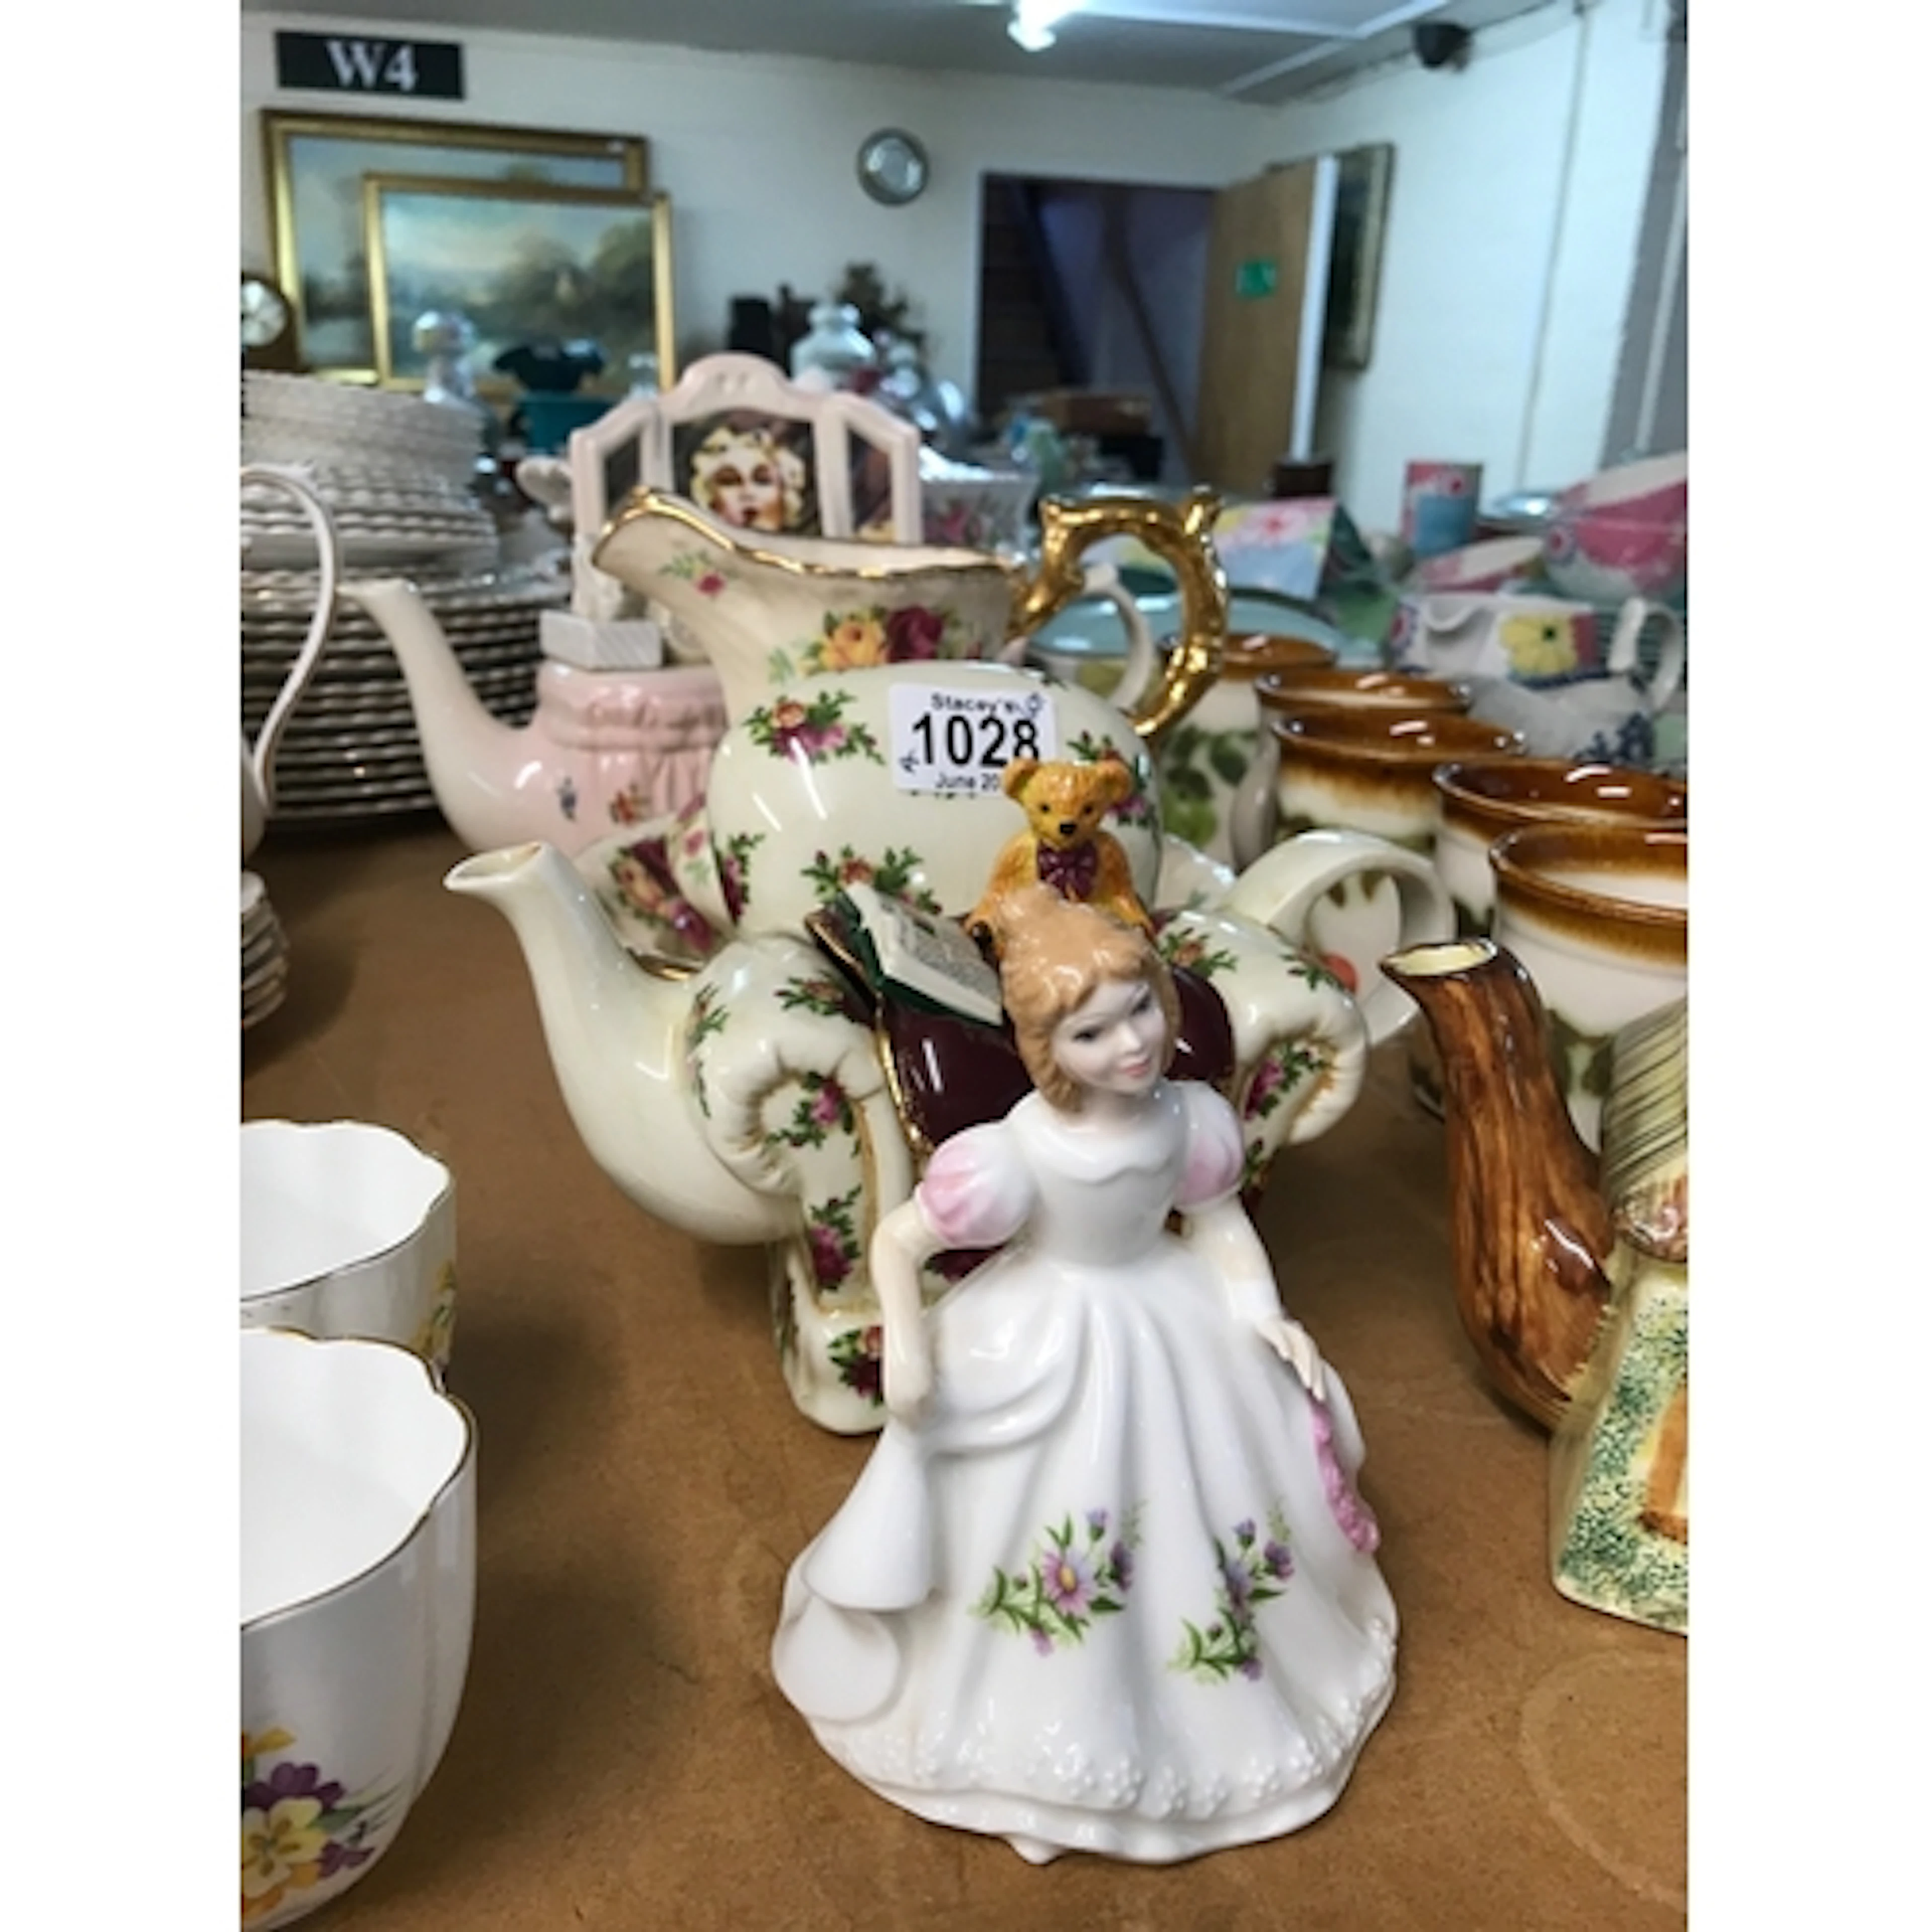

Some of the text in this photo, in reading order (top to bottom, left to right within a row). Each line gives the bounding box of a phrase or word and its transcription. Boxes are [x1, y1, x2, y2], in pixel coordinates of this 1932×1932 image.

[324, 39, 418, 92] W4
[912, 711, 1039, 768] 1028
[935, 772, 976, 789] June
